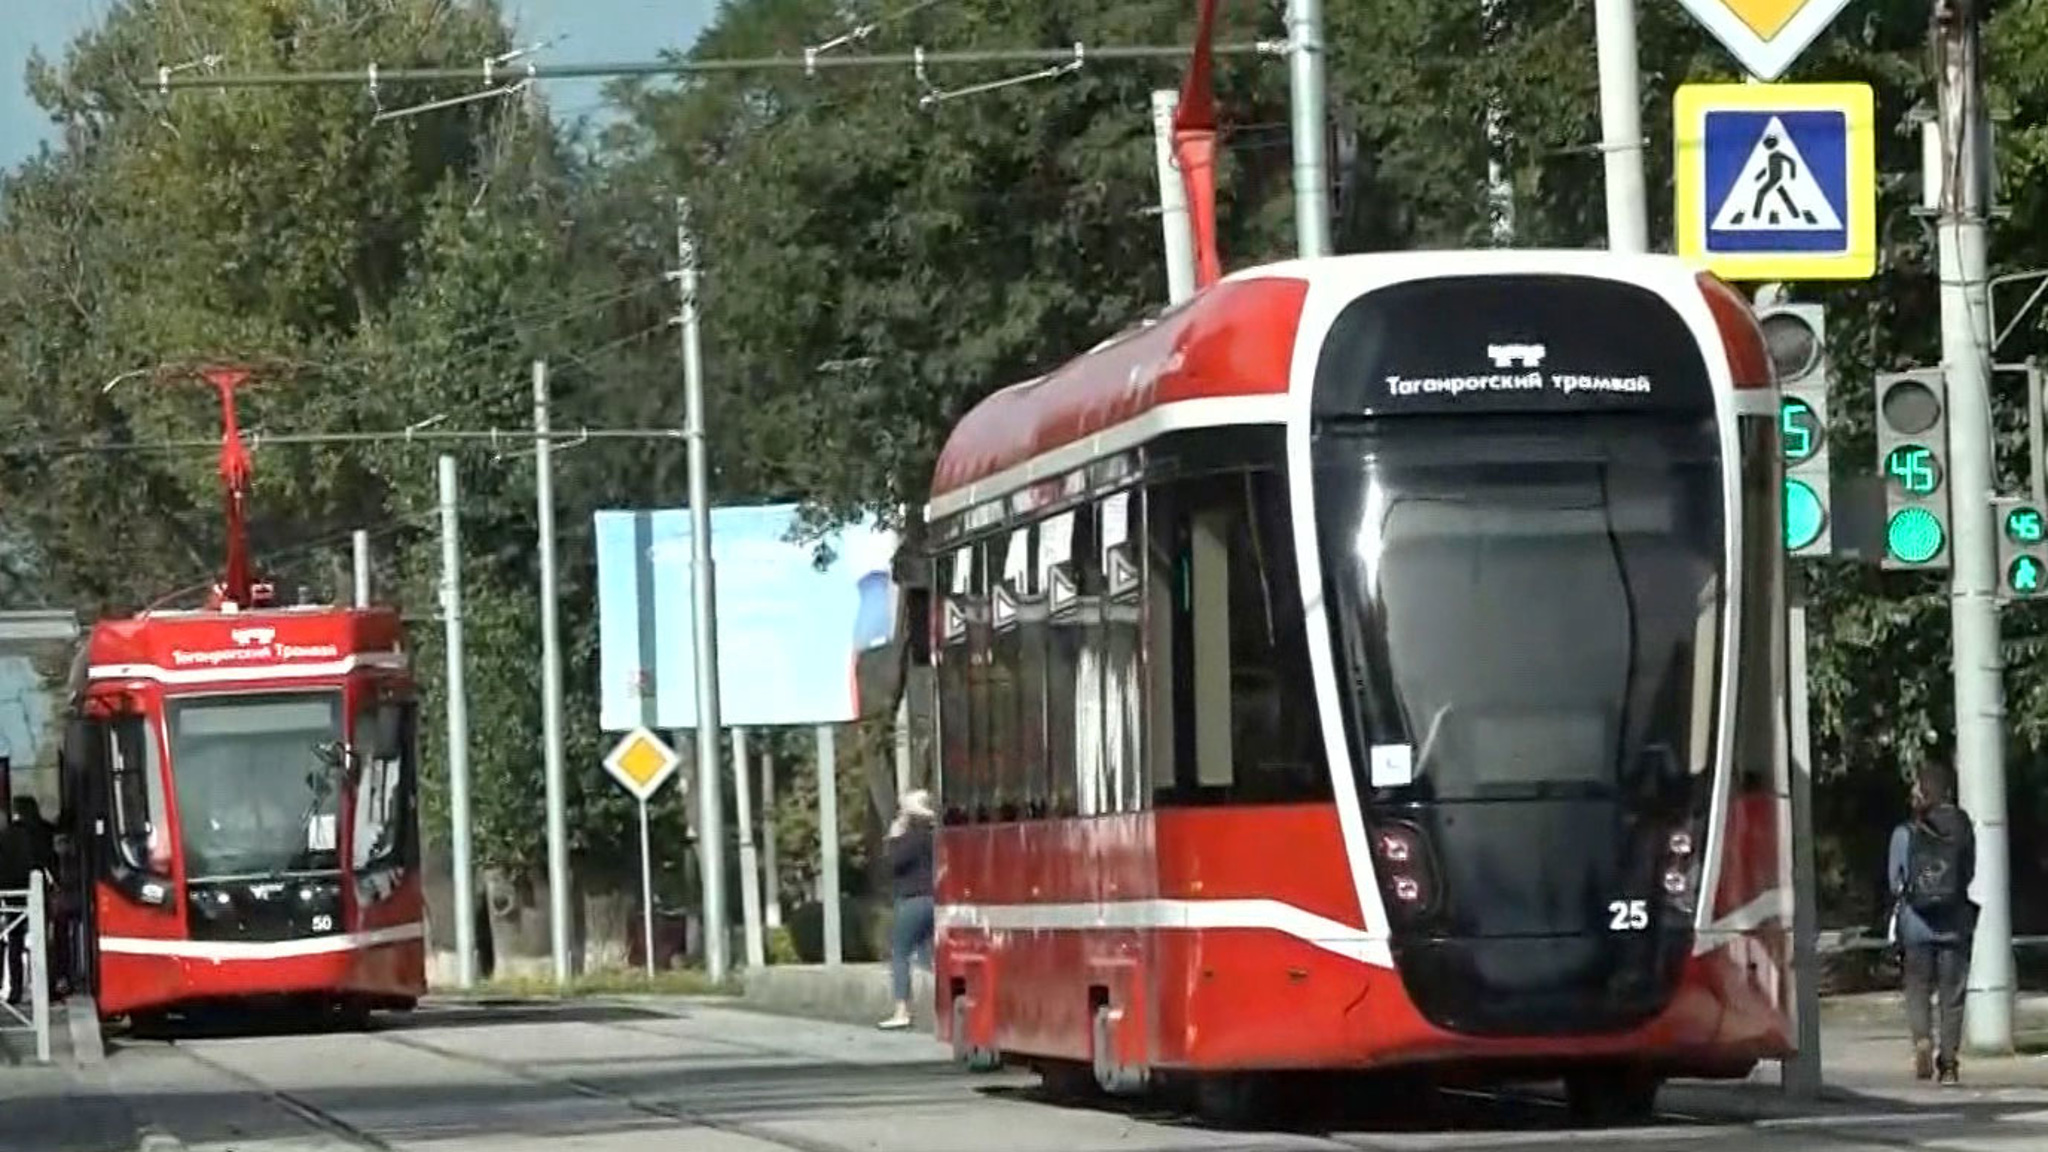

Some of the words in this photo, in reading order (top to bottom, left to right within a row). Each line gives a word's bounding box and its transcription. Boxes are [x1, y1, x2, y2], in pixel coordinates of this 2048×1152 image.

[1385, 371, 1542, 396] Таганрогский
[1890, 450, 1934, 491] 45
[2010, 513, 2041, 540] 45
[311, 914, 332, 932] 50
[1608, 899, 1649, 931] 25
